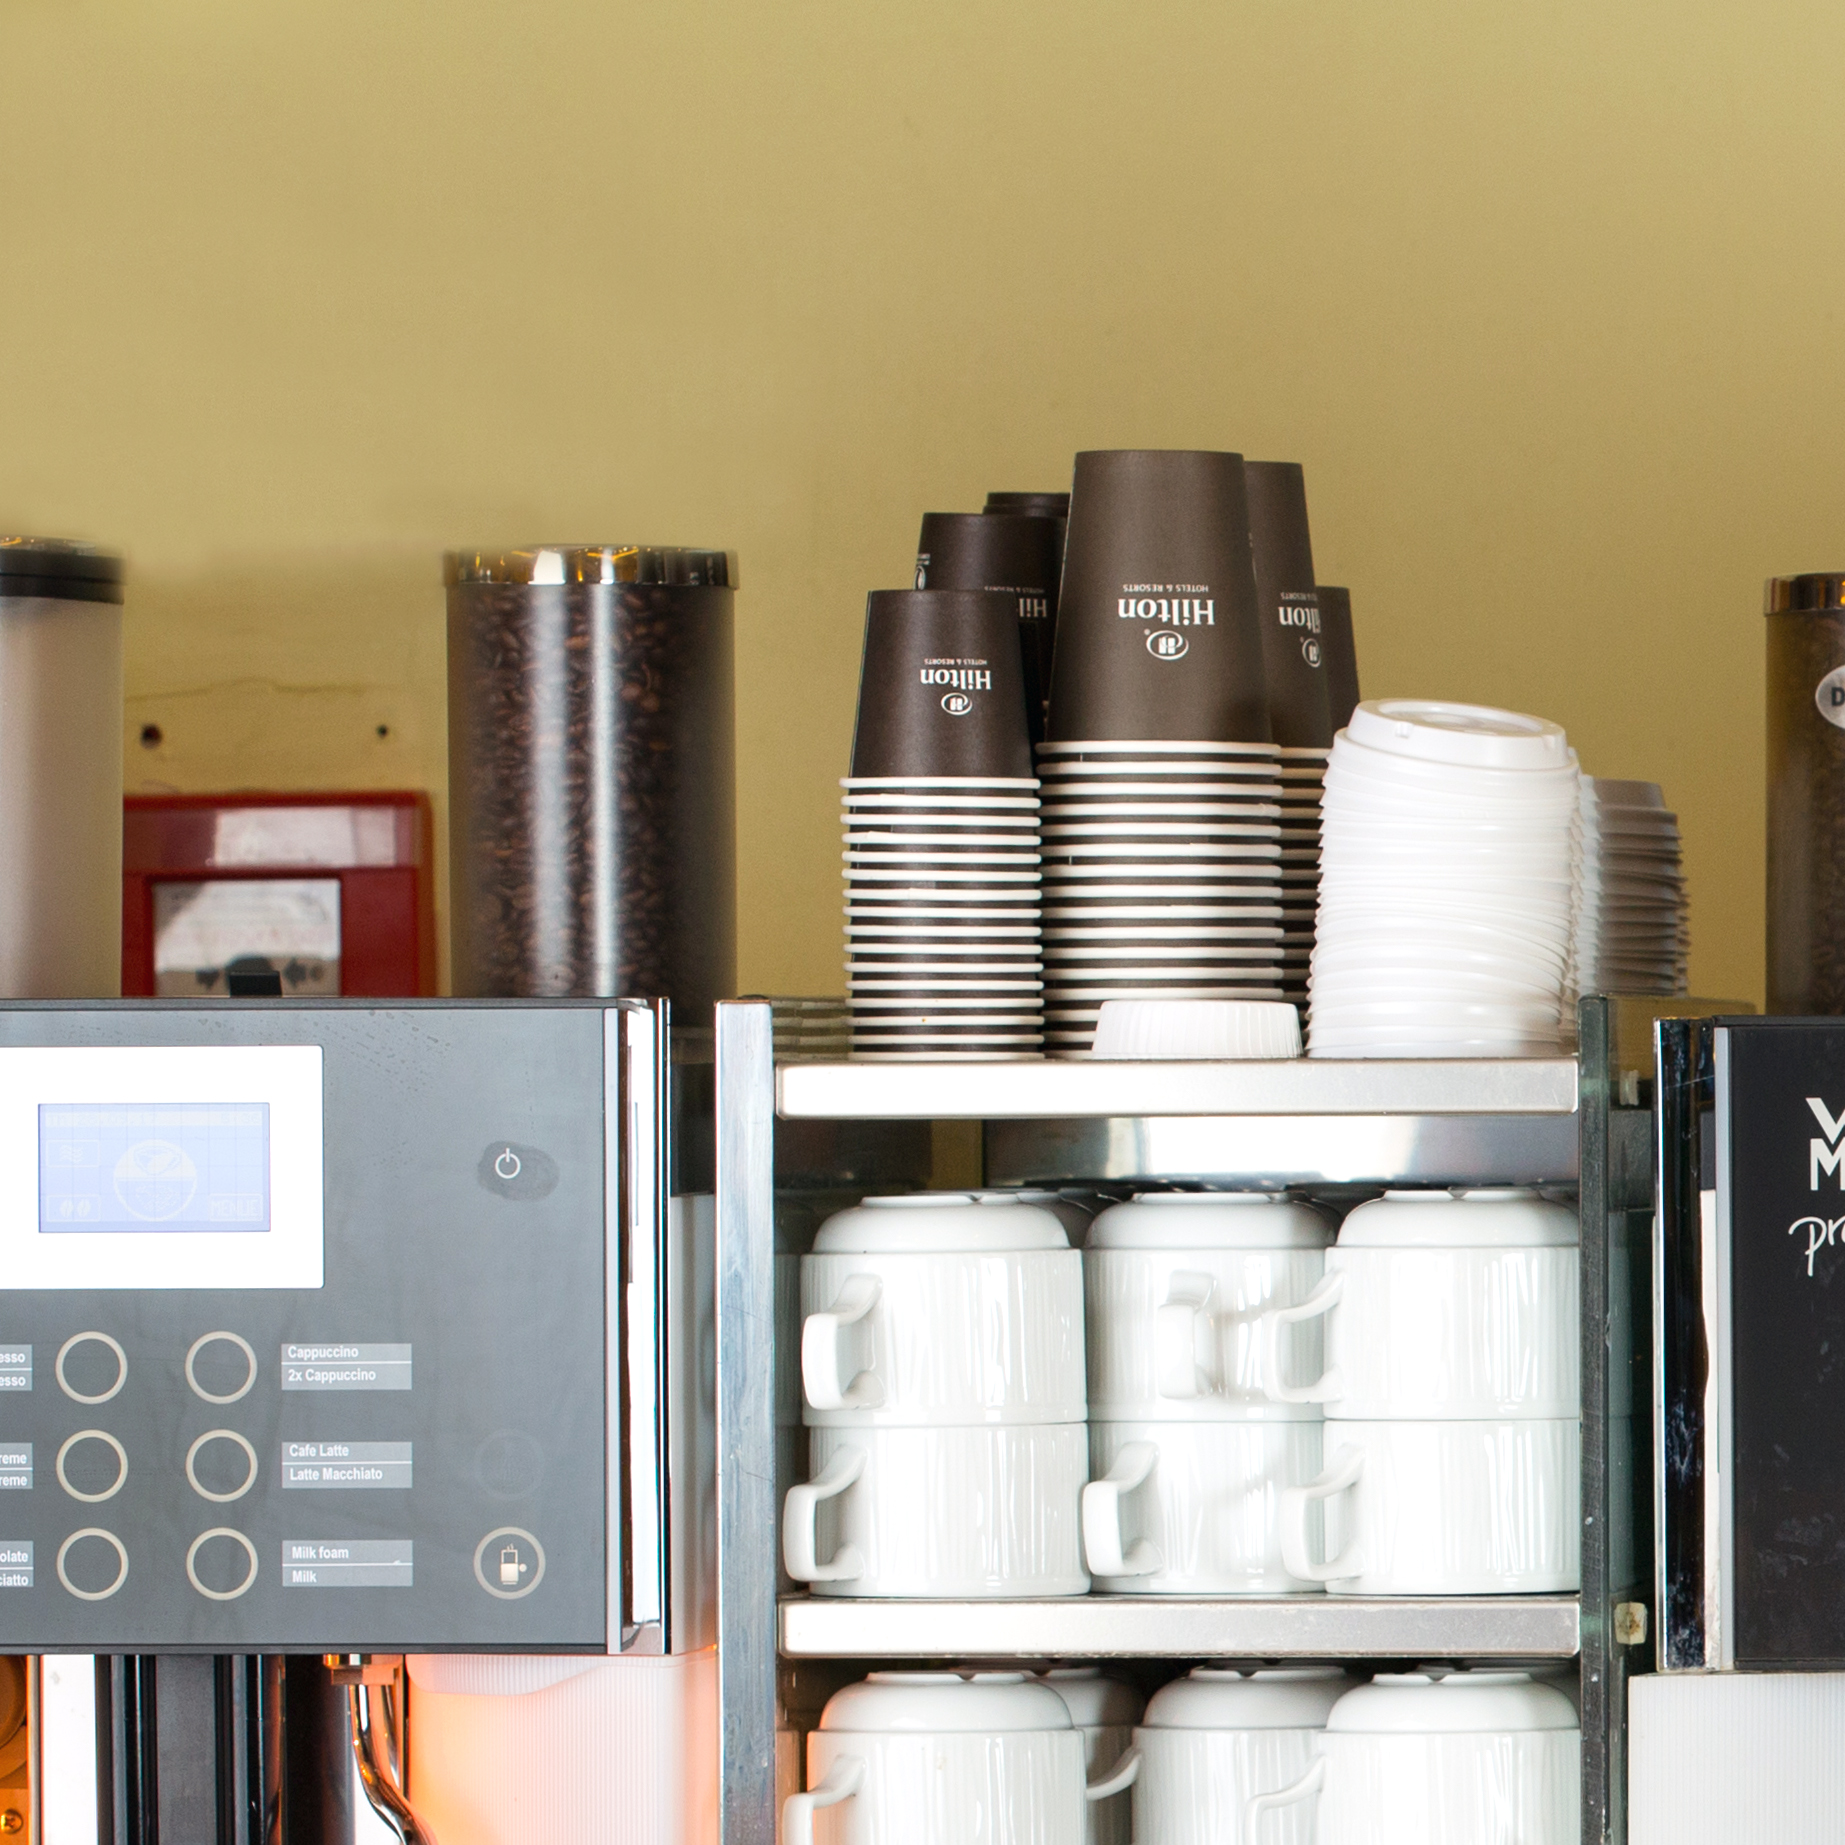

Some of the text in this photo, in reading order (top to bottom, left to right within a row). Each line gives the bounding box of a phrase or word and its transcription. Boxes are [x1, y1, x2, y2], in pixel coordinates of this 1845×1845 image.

[1123, 584, 1209, 592] HOTELS & RESORTS
[1018, 598, 1048, 618] Hil
[1117, 598, 1216, 626] Hilton
[1278, 606, 1321, 634] ilton
[919, 668, 991, 690] Hilton
[0, 1353, 26, 1363] esso
[287, 1345, 359, 1361] Cappuccino
[0, 1376, 26, 1386] esso
[288, 1368, 376, 1384] 2x Cappuccino
[289, 1444, 349, 1457] Cafe Latte
[0, 1453, 27, 1464] reme
[290, 1467, 383, 1480] Latte Macchiato
[0, 1475, 27, 1486] reme
[0, 1551, 29, 1562] olate
[292, 1546, 349, 1559] Milk foam
[0, 1575, 29, 1587] ciatto
[292, 1570, 317, 1583] Milk
